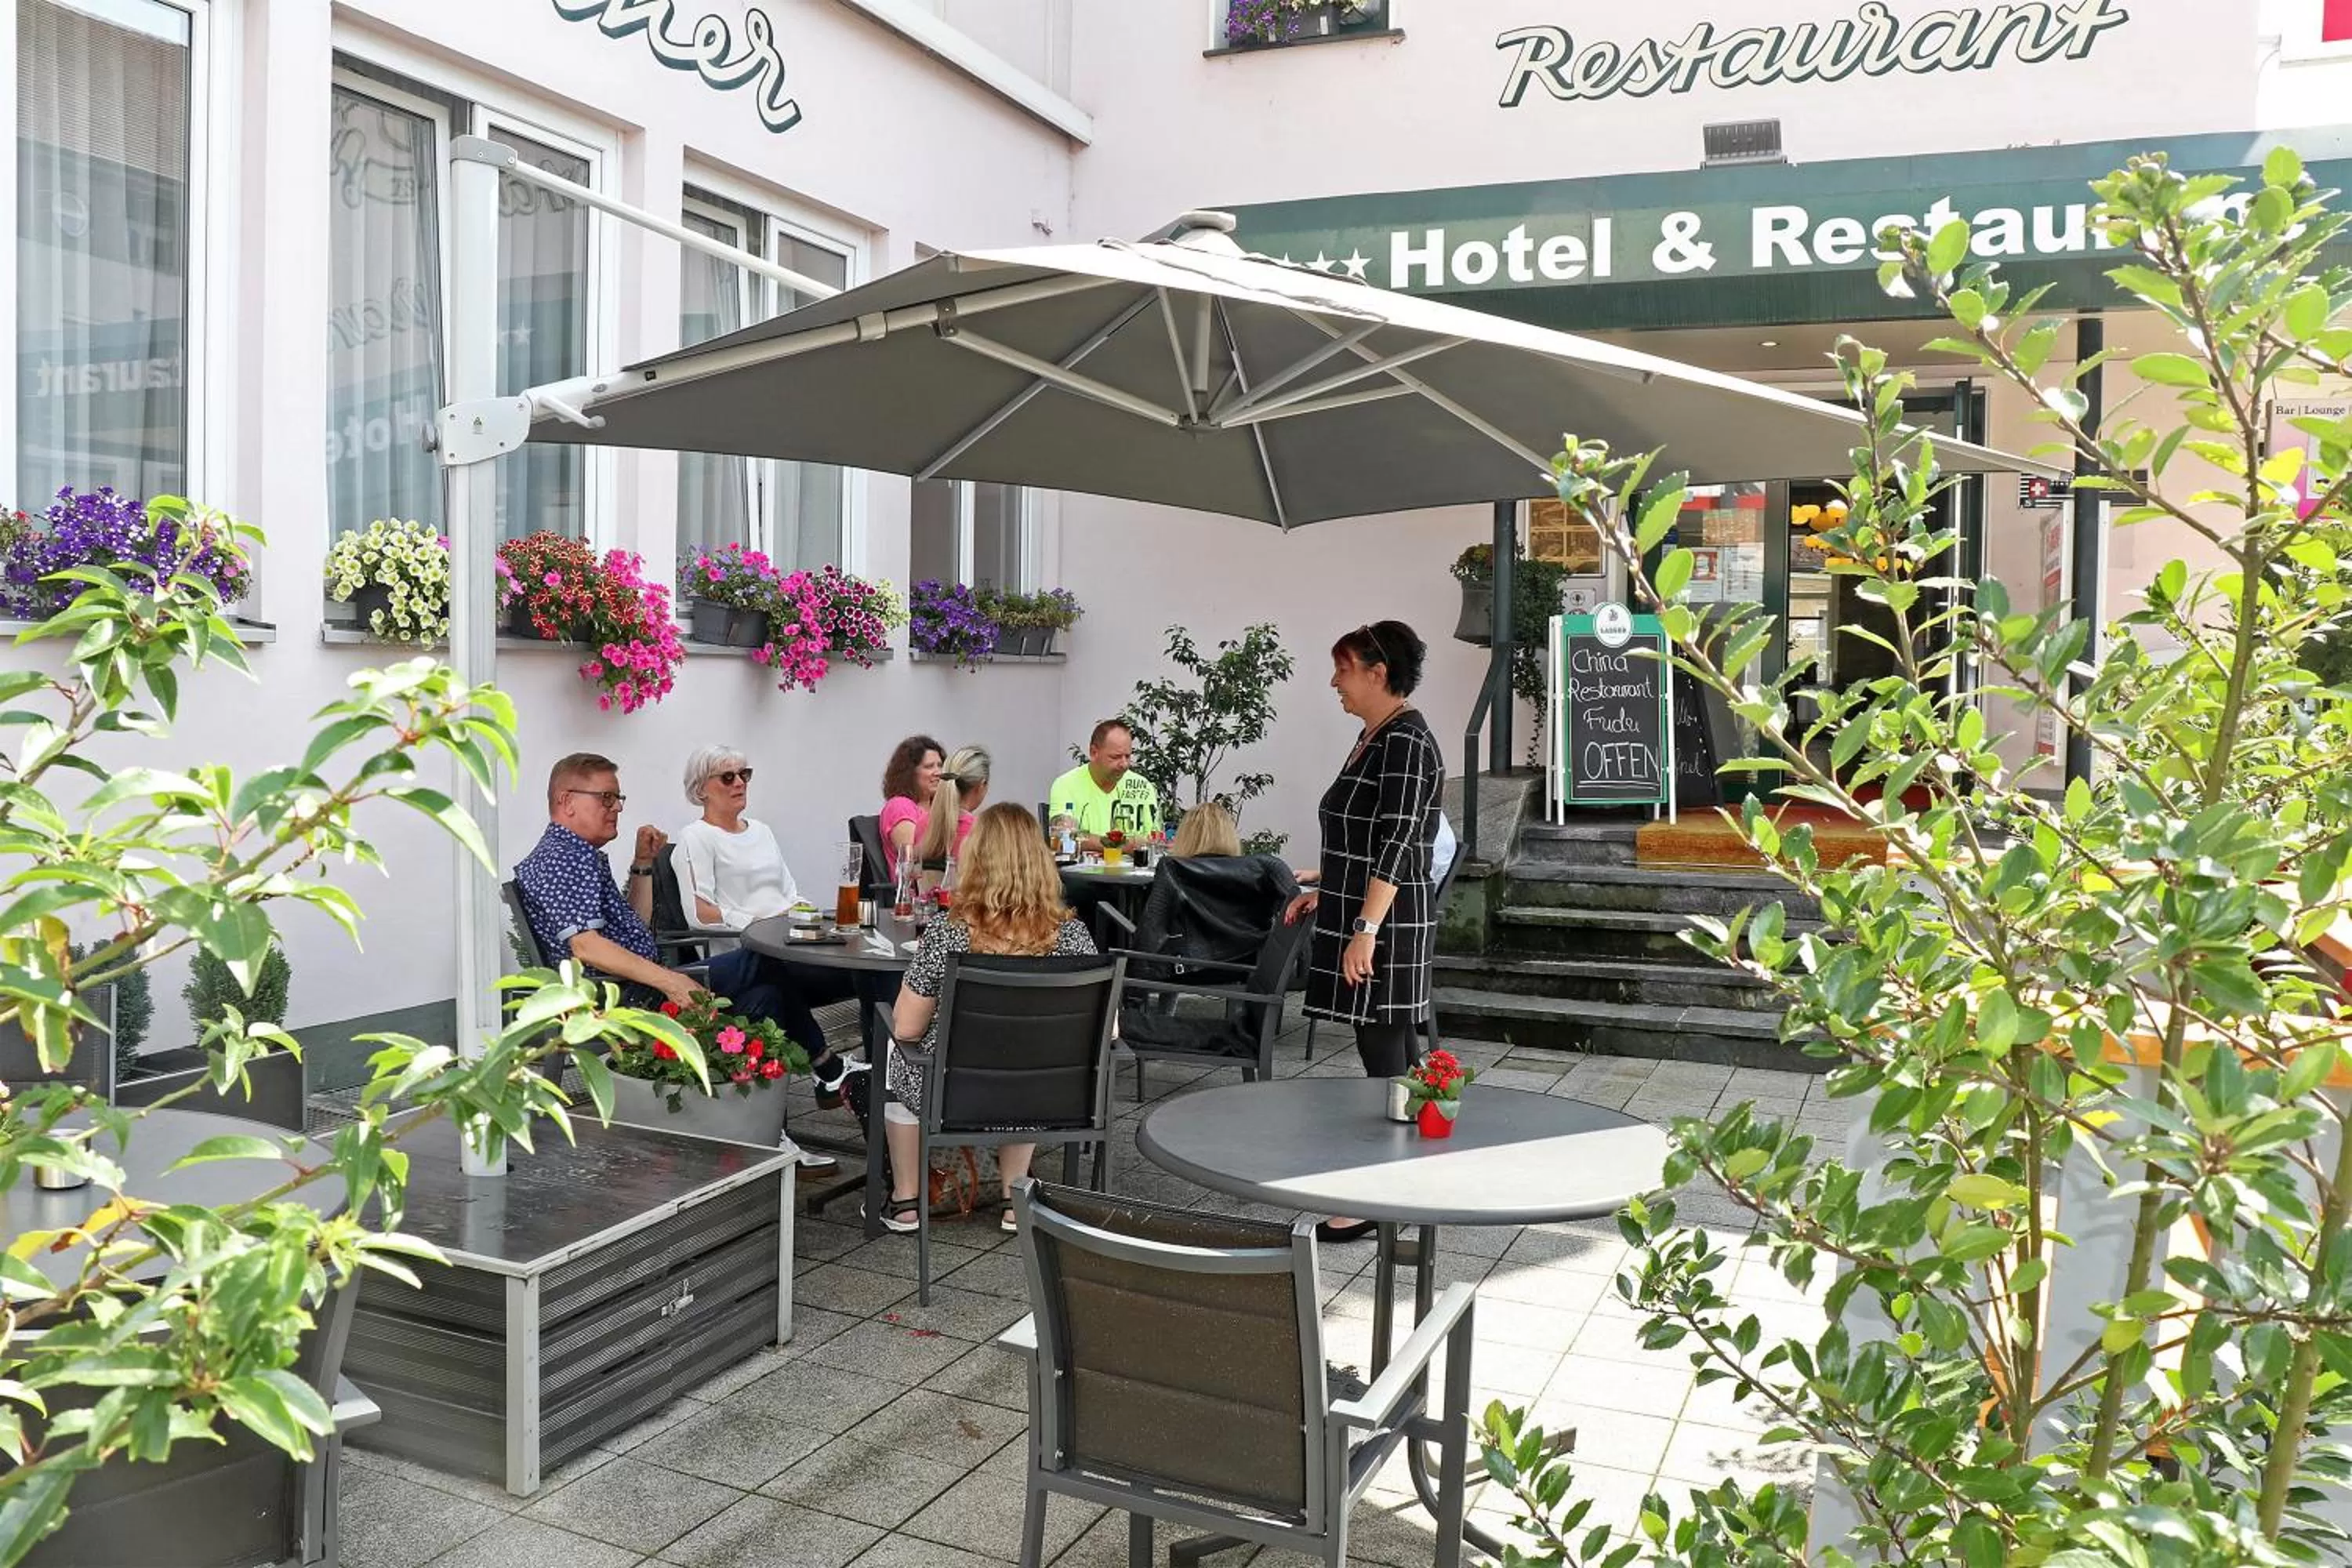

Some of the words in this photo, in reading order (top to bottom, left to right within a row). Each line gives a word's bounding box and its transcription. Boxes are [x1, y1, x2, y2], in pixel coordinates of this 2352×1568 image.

[1496, 0, 2130, 108] Restaurant
[1390, 217, 1612, 289] Hotel
[1652, 211, 1717, 274] &
[1751, 192, 2262, 268] Restau
[2275, 405, 2296, 415] Bar
[2304, 405, 2346, 416] Lounge
[1572, 648, 1629, 673] China
[1569, 674, 1655, 703] Restaurant
[1584, 742, 1661, 779] OFFEN
[1125, 779, 1147, 789] RUN
